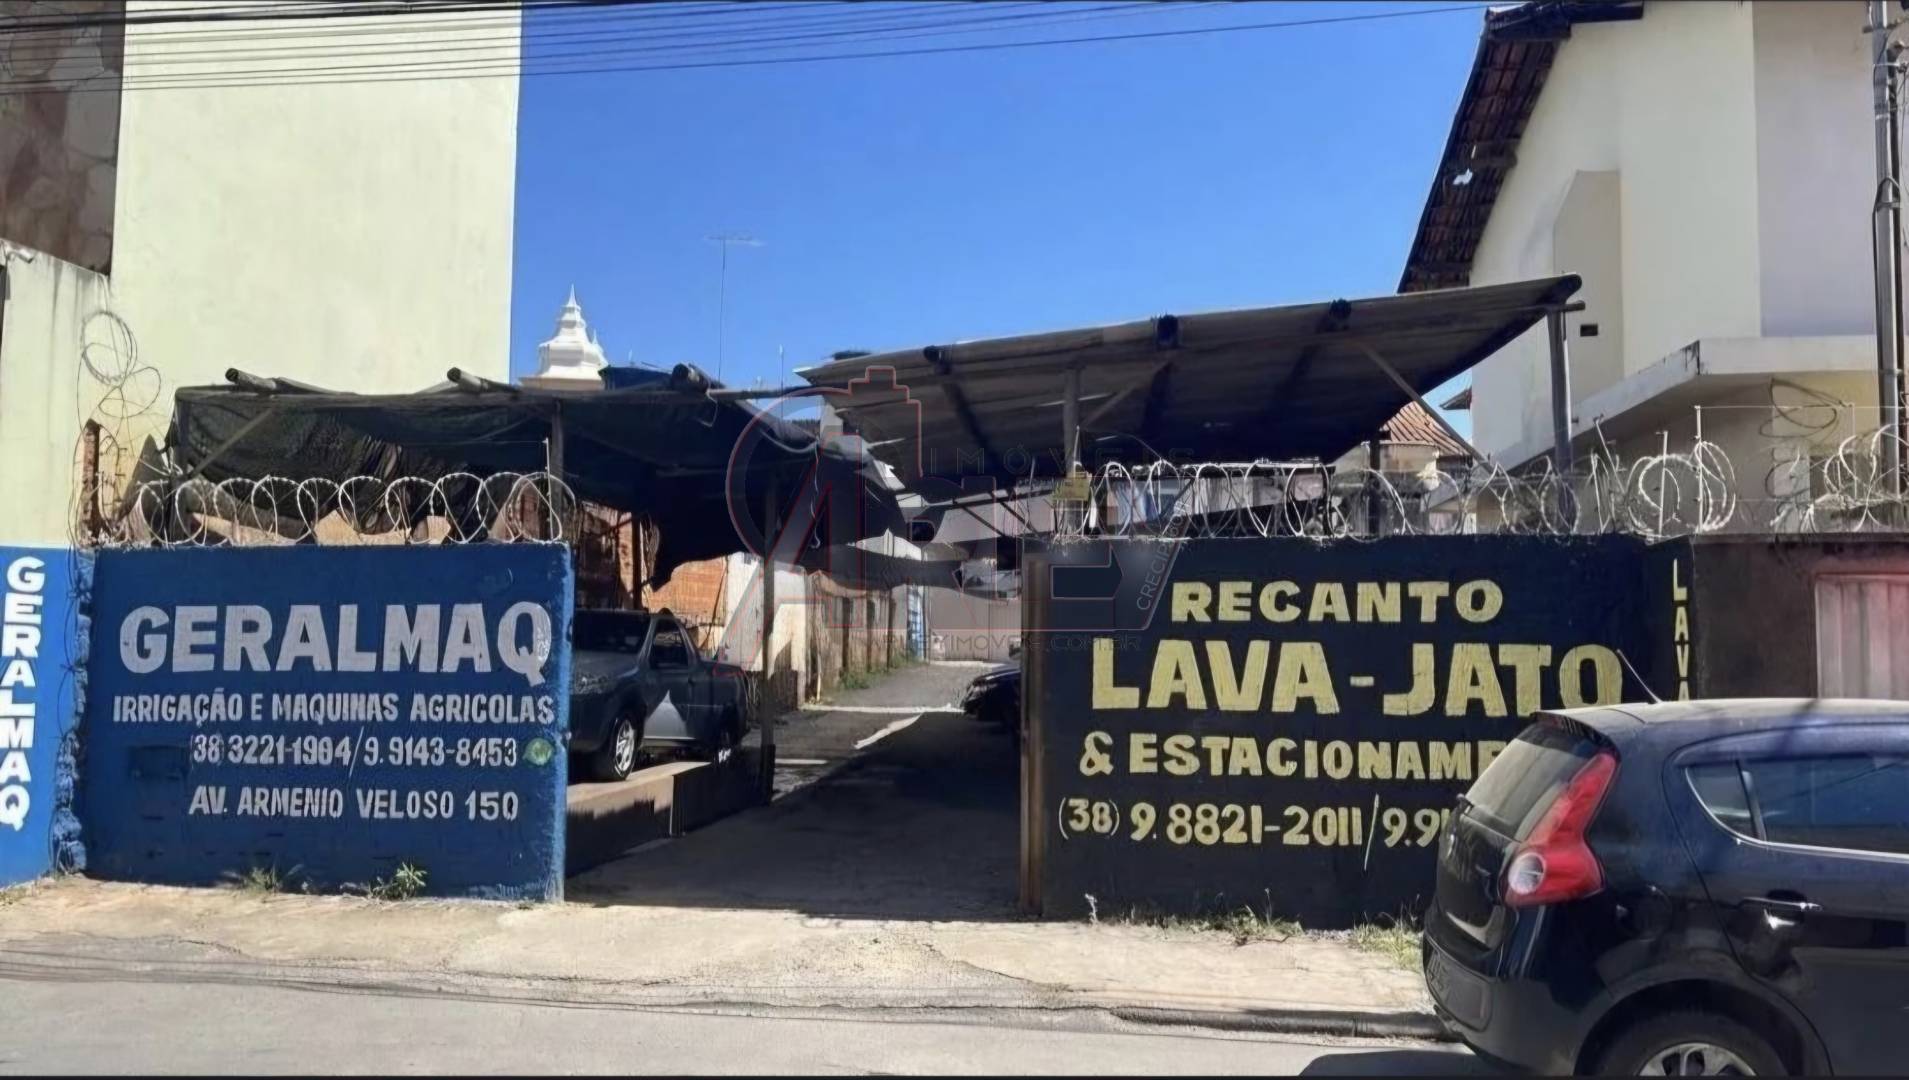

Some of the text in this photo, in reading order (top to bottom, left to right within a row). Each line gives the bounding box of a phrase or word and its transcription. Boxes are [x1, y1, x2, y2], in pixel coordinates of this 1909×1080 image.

[1171, 579, 1504, 623] RECANTO
[119, 601, 552, 687] GERALMAQ
[0, 556, 46, 832] GERALMAQ
[113, 687, 556, 727] IRRIGAÇÃO E MAQUINAS AGRICOLAS
[1079, 731, 1115, 777] &
[189, 786, 519, 821] AV. ARMENIO VELOSO 150
[1058, 796, 1120, 841] (38)
